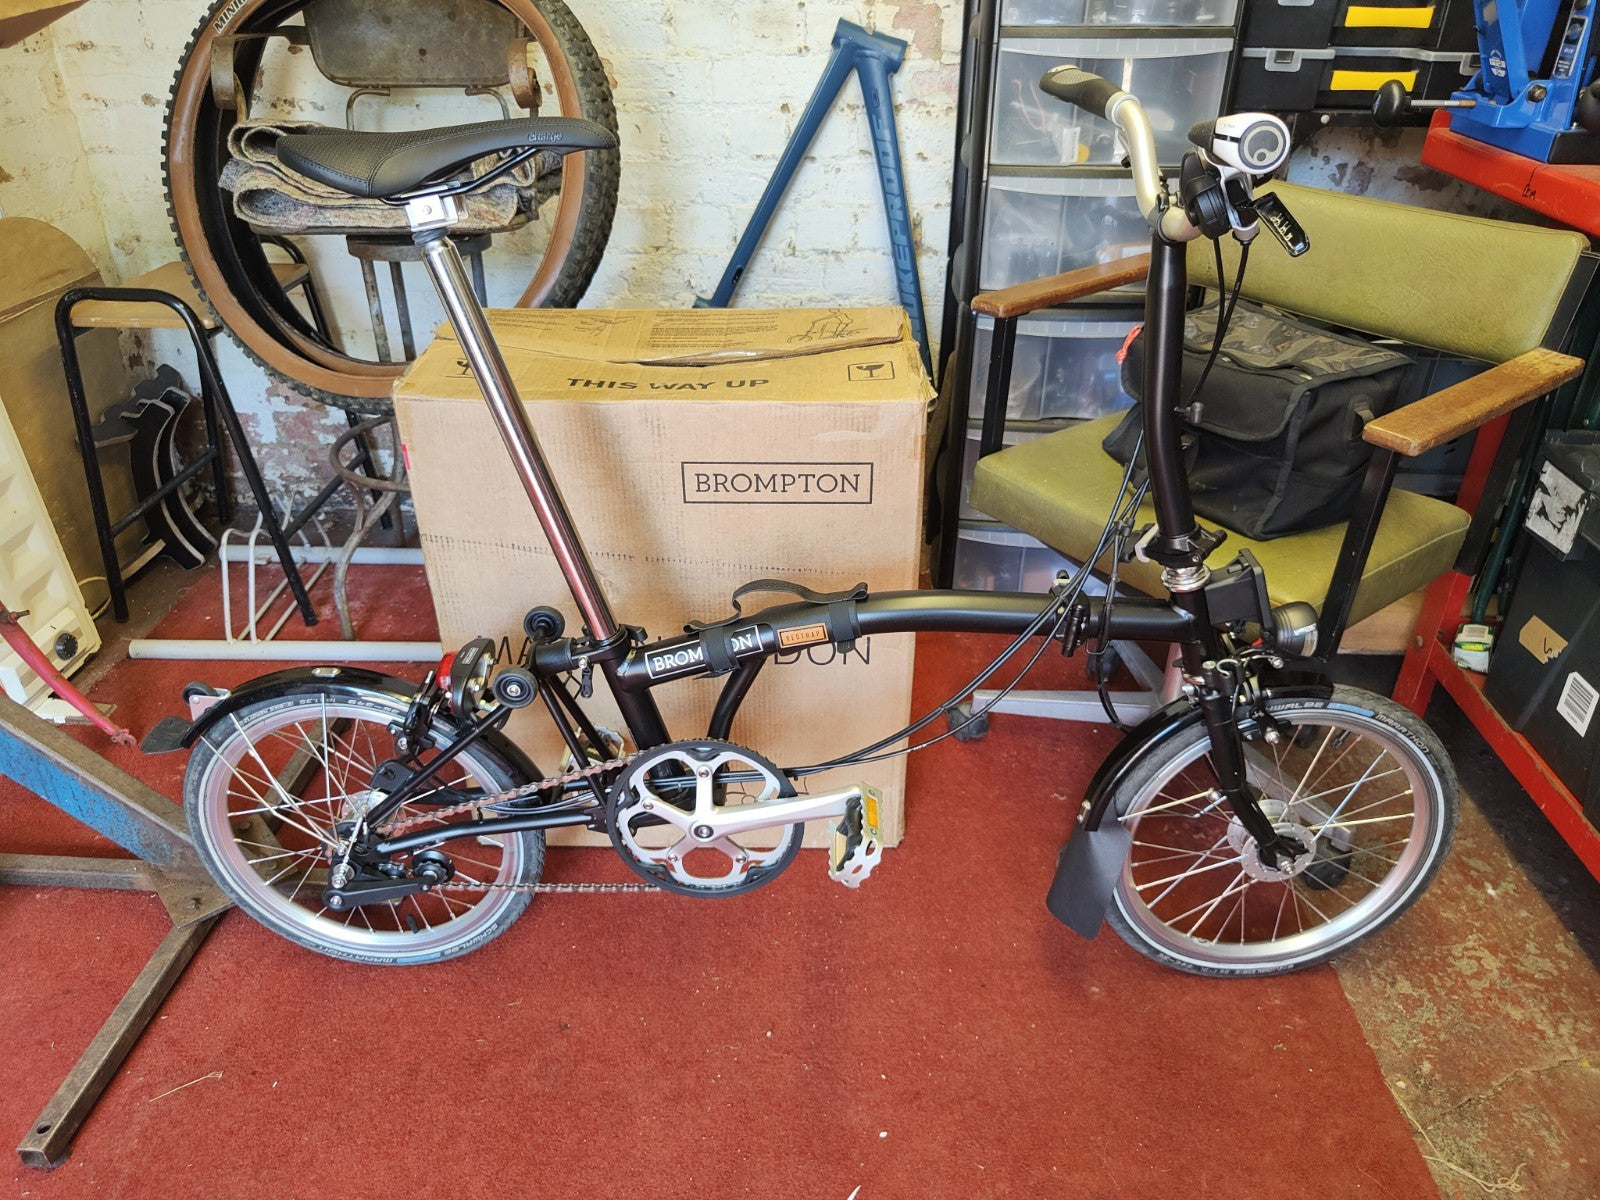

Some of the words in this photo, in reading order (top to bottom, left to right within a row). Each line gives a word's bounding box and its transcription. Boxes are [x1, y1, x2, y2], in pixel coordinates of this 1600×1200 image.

[528, 131, 563, 142] charge
[567, 378, 638, 389] THIS
[649, 381, 716, 390] WAY
[725, 379, 770, 388] UP
[695, 473, 860, 493] BROMPTON
[652, 633, 754, 673] BROMON
[1375, 713, 1430, 754] MARATHON
[445, 922, 499, 955] SCHWALBE
[318, 945, 393, 963] MARATHON
